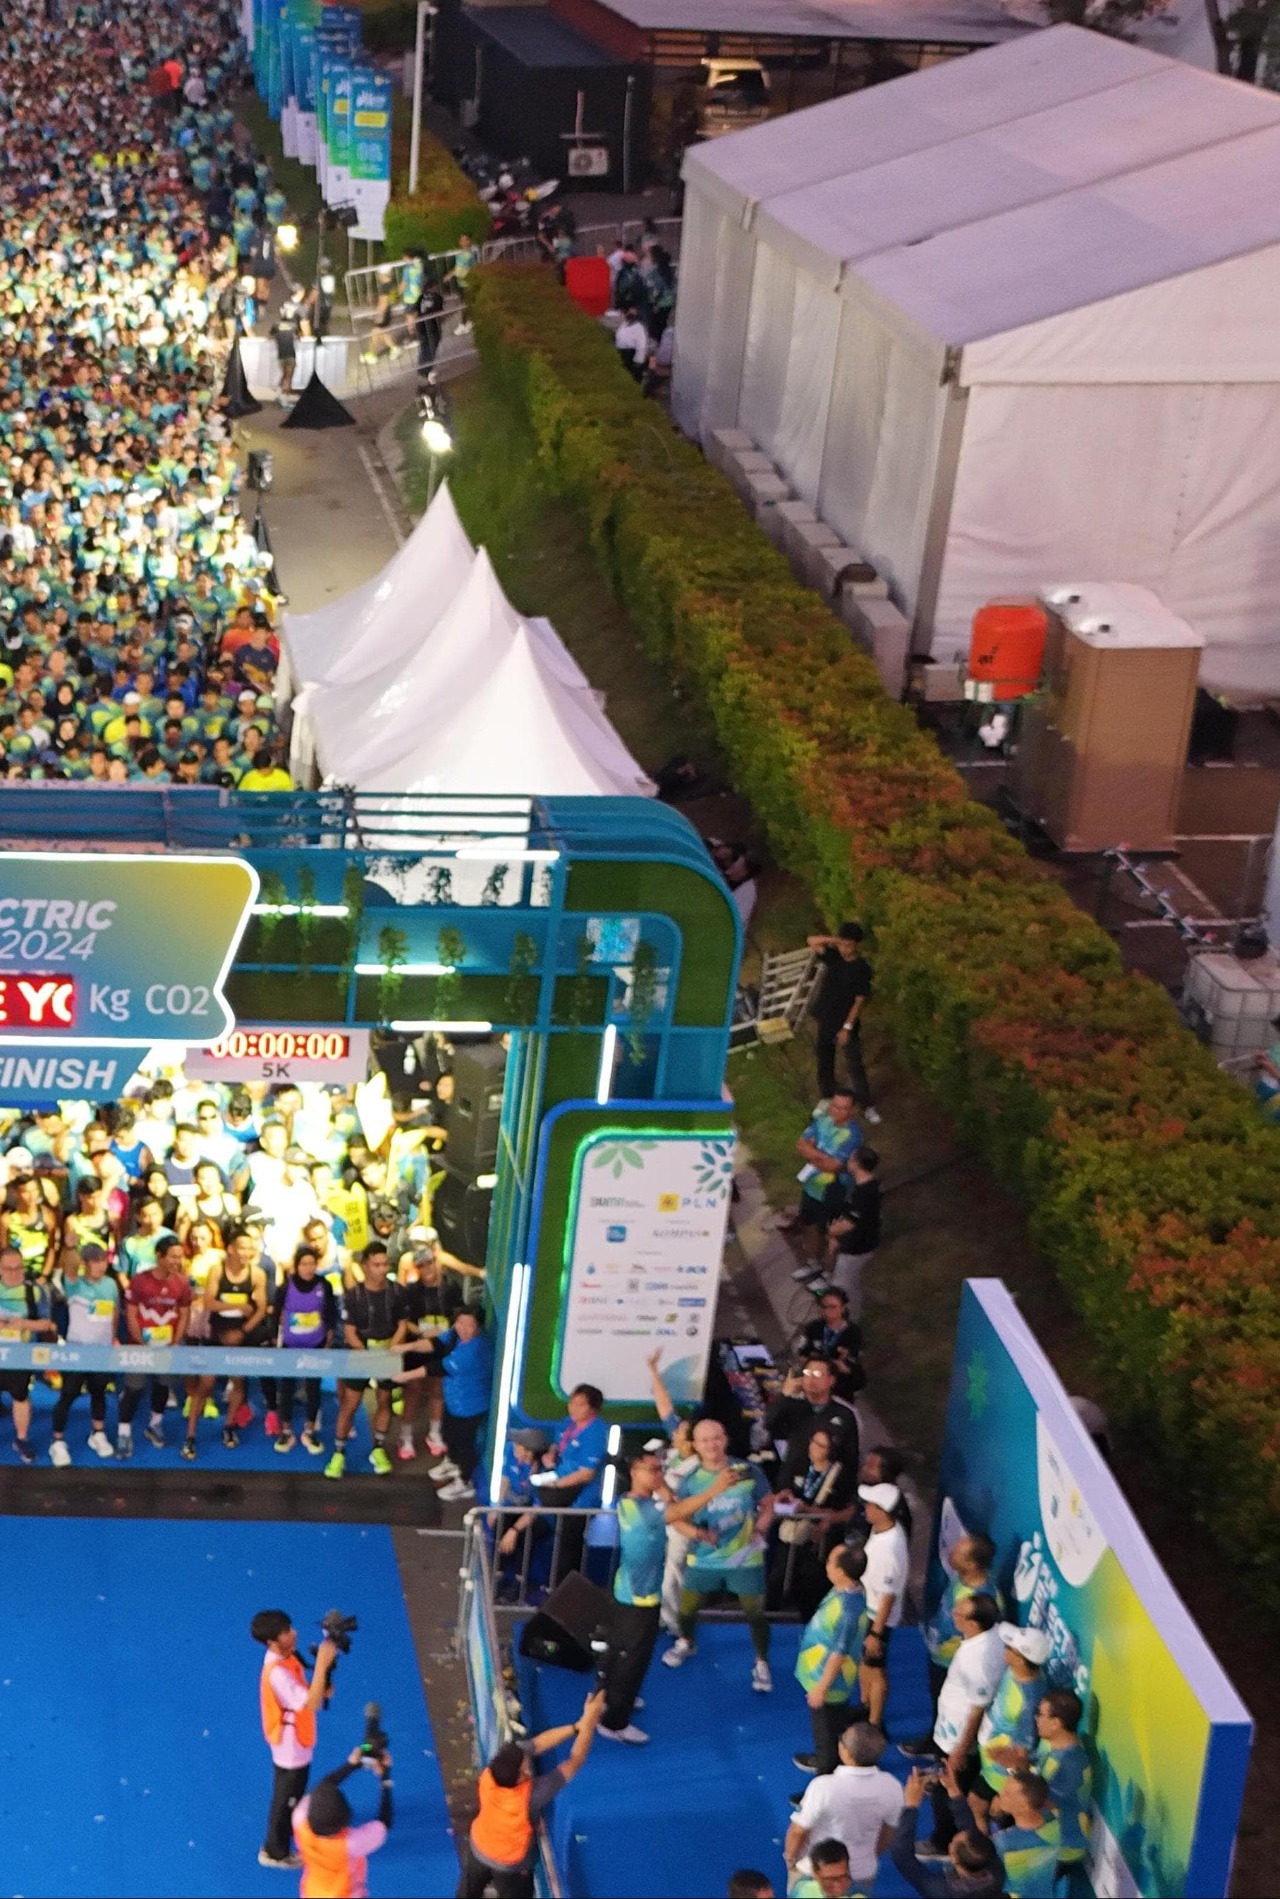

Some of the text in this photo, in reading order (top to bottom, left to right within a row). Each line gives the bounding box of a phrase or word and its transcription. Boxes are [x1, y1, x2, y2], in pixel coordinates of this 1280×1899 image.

[89, 983, 210, 1021] Kg CO2
[261, 1062, 291, 1078] 5K
[120, 1351, 154, 1367] 10K
